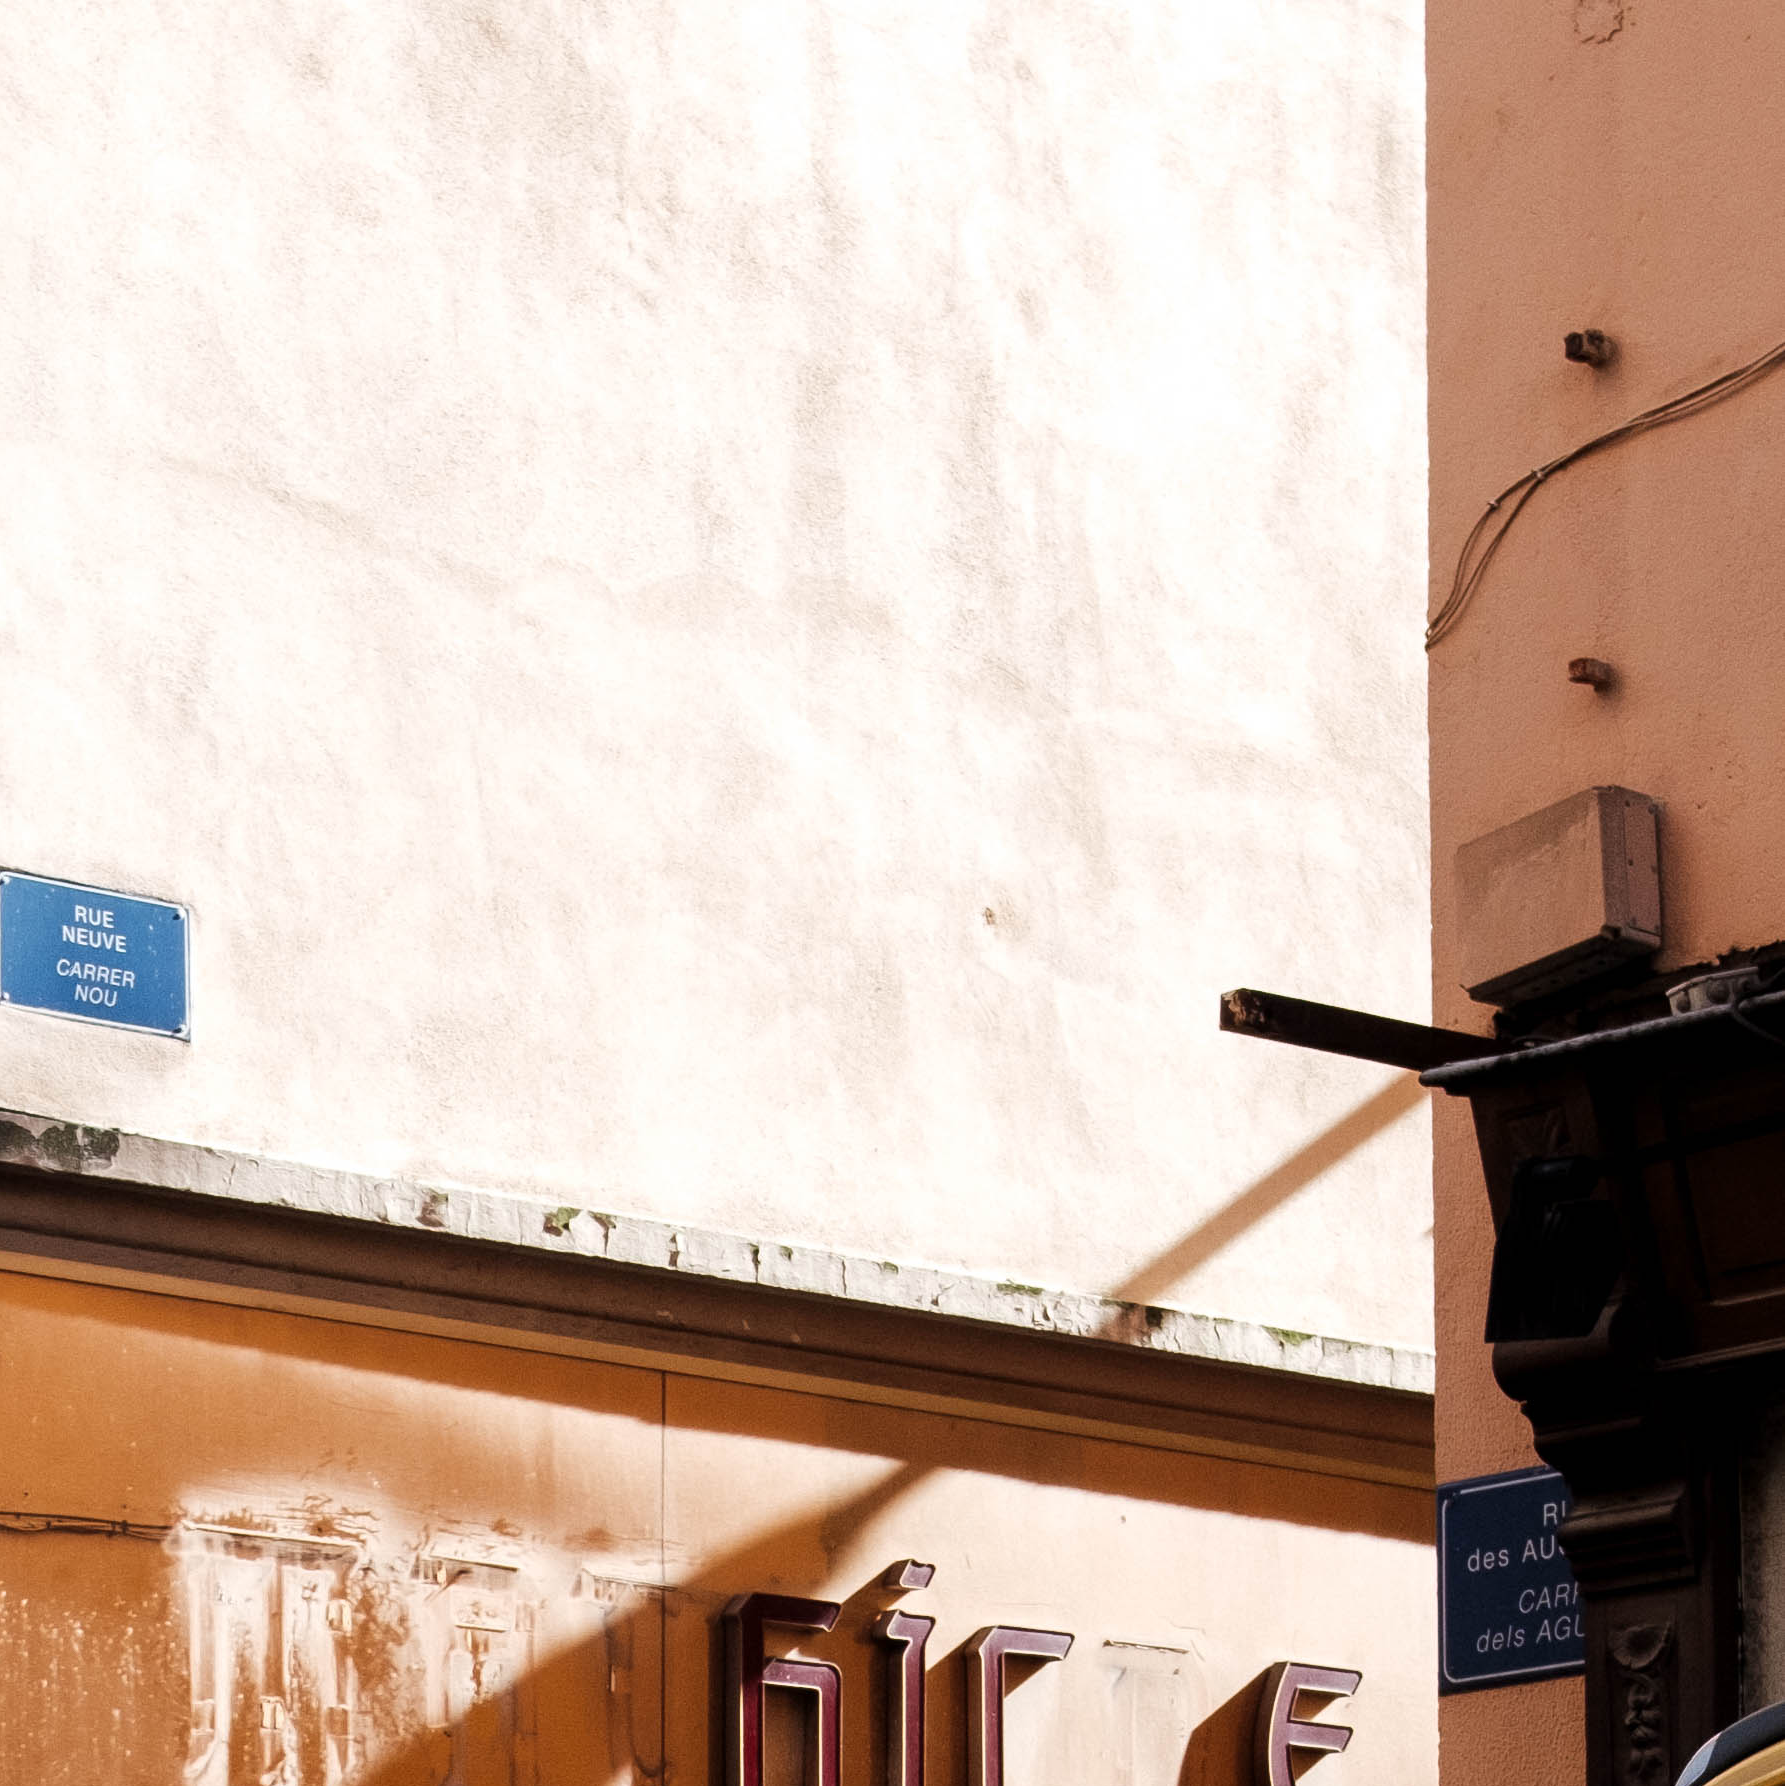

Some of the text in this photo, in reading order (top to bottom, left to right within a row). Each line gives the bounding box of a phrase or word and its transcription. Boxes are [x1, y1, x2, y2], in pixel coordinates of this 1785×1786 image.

[74, 904, 114, 929] RUE
[62, 925, 127, 953] NEUVE
[56, 958, 135, 989] CARRER
[74, 984, 118, 1007] NOU
[1543, 1500, 1567, 1527] R
[1467, 1535, 1565, 1573] des AU
[1476, 1614, 1586, 1654] dels AGU
